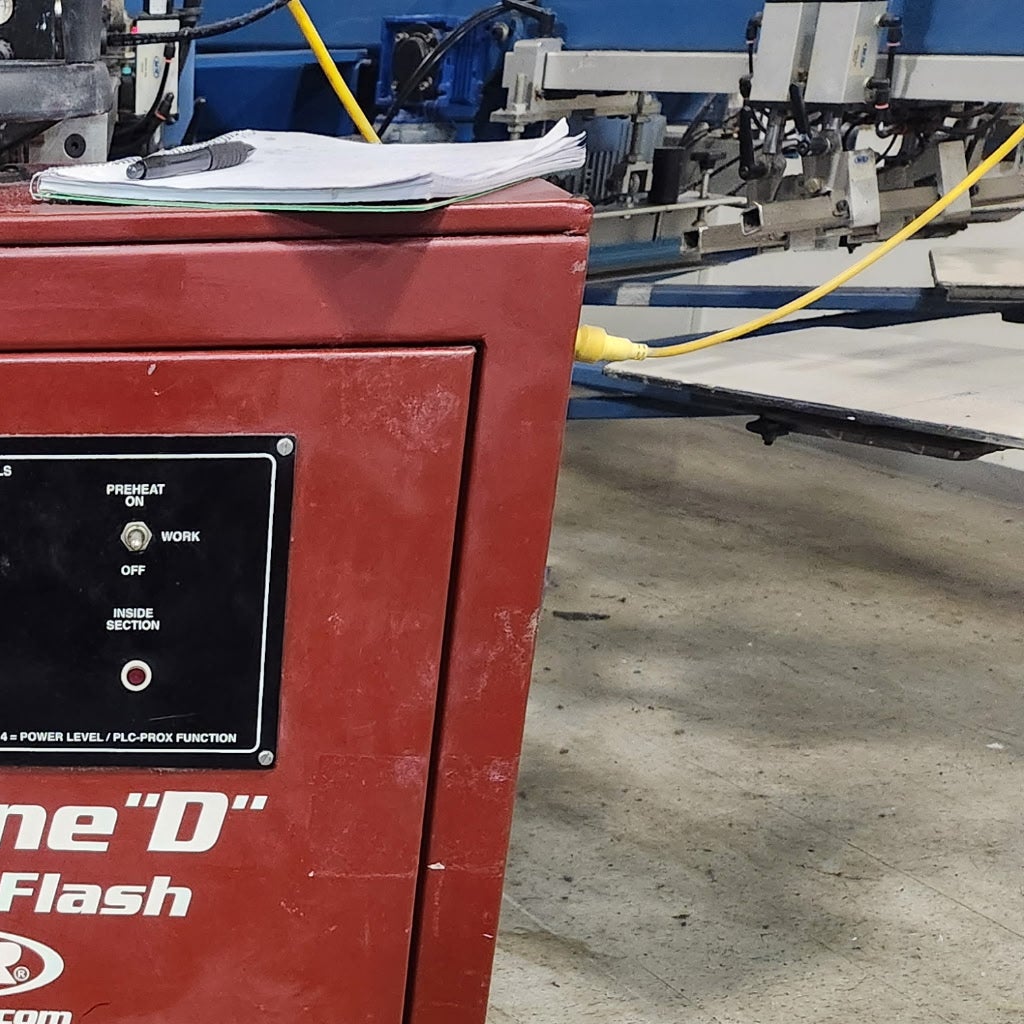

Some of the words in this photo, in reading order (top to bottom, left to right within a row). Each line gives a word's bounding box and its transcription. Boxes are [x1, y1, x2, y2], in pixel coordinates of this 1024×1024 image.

[106, 483, 166, 496] PREHEAT
[124, 496, 145, 508] ON
[161, 531, 201, 543] WORK
[120, 564, 146, 576] OFF
[113, 607, 154, 619] INSIDE
[106, 619, 161, 631] SECTION
[19, 731, 64, 743] POWER
[66, 731, 104, 743] LEVEL
[112, 732, 174, 743] PLC-PROX
[175, 732, 238, 744] FUNCTION
